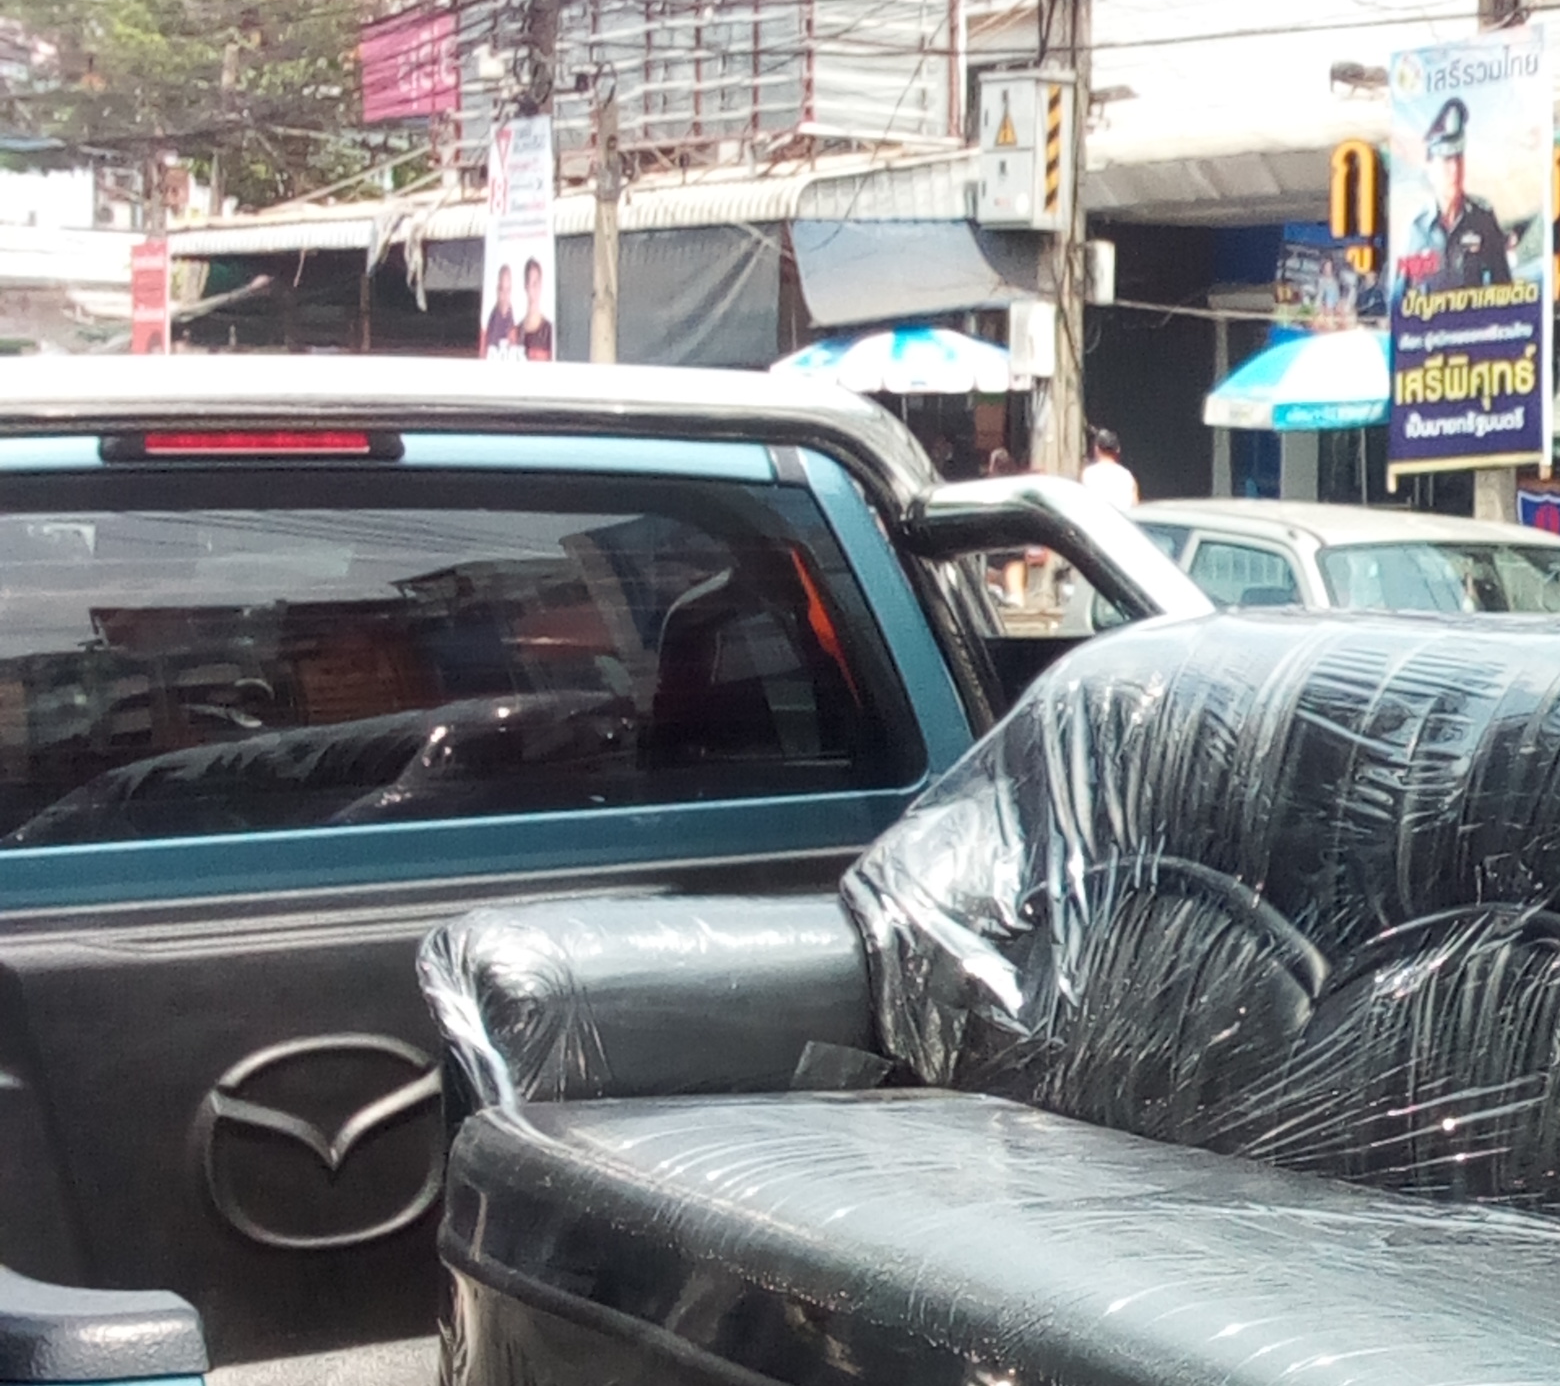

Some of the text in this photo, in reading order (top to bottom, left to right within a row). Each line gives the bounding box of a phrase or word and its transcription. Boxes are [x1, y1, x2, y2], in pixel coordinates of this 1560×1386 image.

[1425, 44, 1540, 93] เสรีรวมไทย
[1395, 343, 1537, 412] เสรีพิศุทธ์
